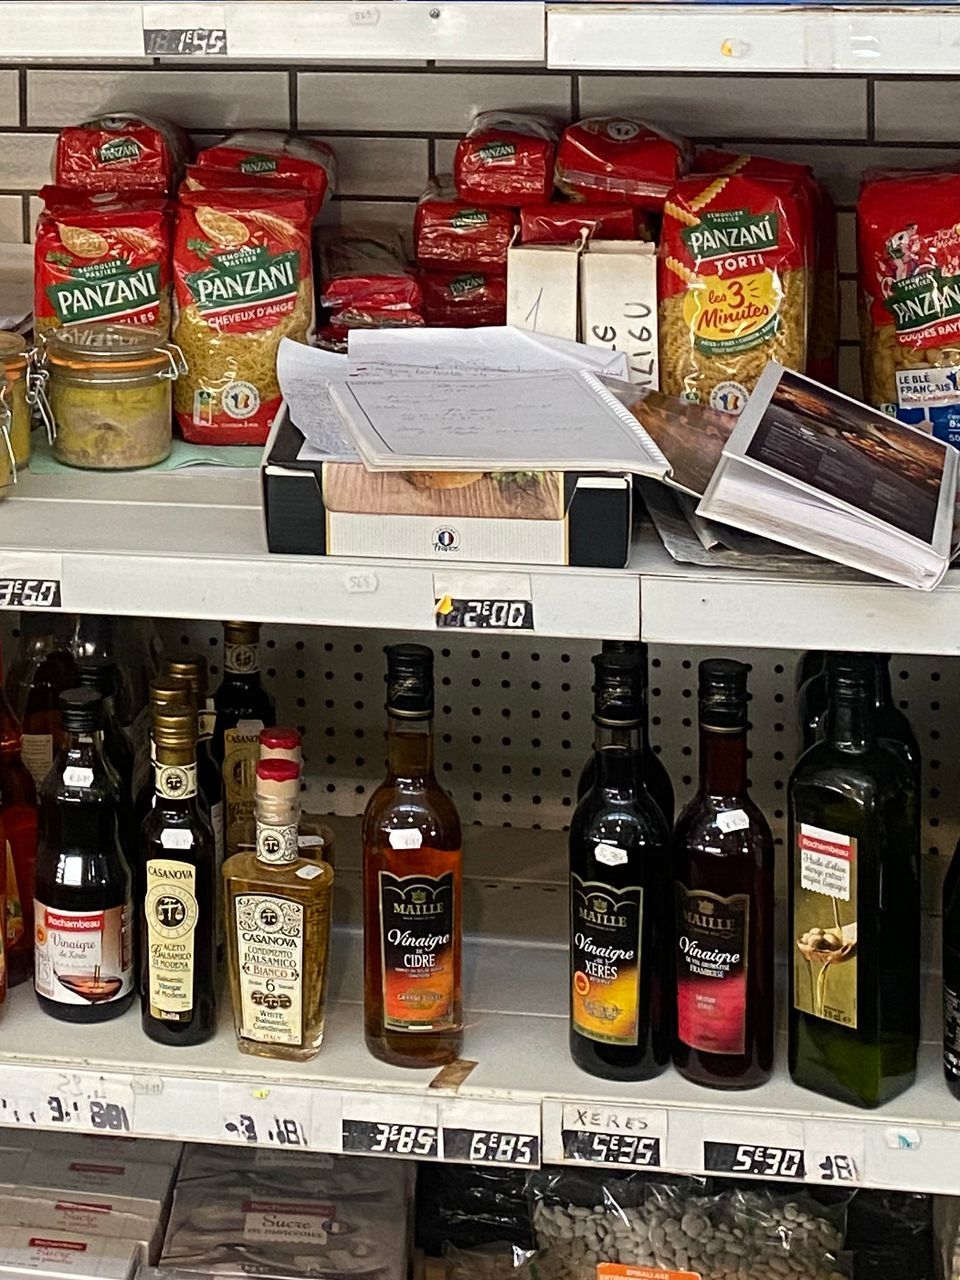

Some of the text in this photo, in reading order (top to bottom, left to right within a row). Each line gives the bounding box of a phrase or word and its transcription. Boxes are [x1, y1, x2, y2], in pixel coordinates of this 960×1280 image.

[690, 220, 773, 253] PANZANI
[714, 254, 764, 273] TORTI
[198, 264, 293, 300] PANZANI
[58, 278, 156, 314] PANZANI
[708, 282, 746, 306] les 3
[893, 282, 960, 325] PANZAN
[209, 301, 293, 327] CHEVEUX D'ANGE
[699, 304, 770, 331] Minutes
[899, 376, 912, 386] LE
[149, 865, 193, 880] CASANOVA
[393, 901, 443, 915] MAILLE
[578, 908, 628, 927] MAILLE
[242, 932, 298, 949] CASANOVA
[388, 929, 449, 947] Vinaigre
[575, 932, 635, 962] Vinaigre
[245, 953, 297, 967] BALSAMICO
[404, 953, 435, 967] CIDRE
[679, 936, 740, 966] Vinaigre
